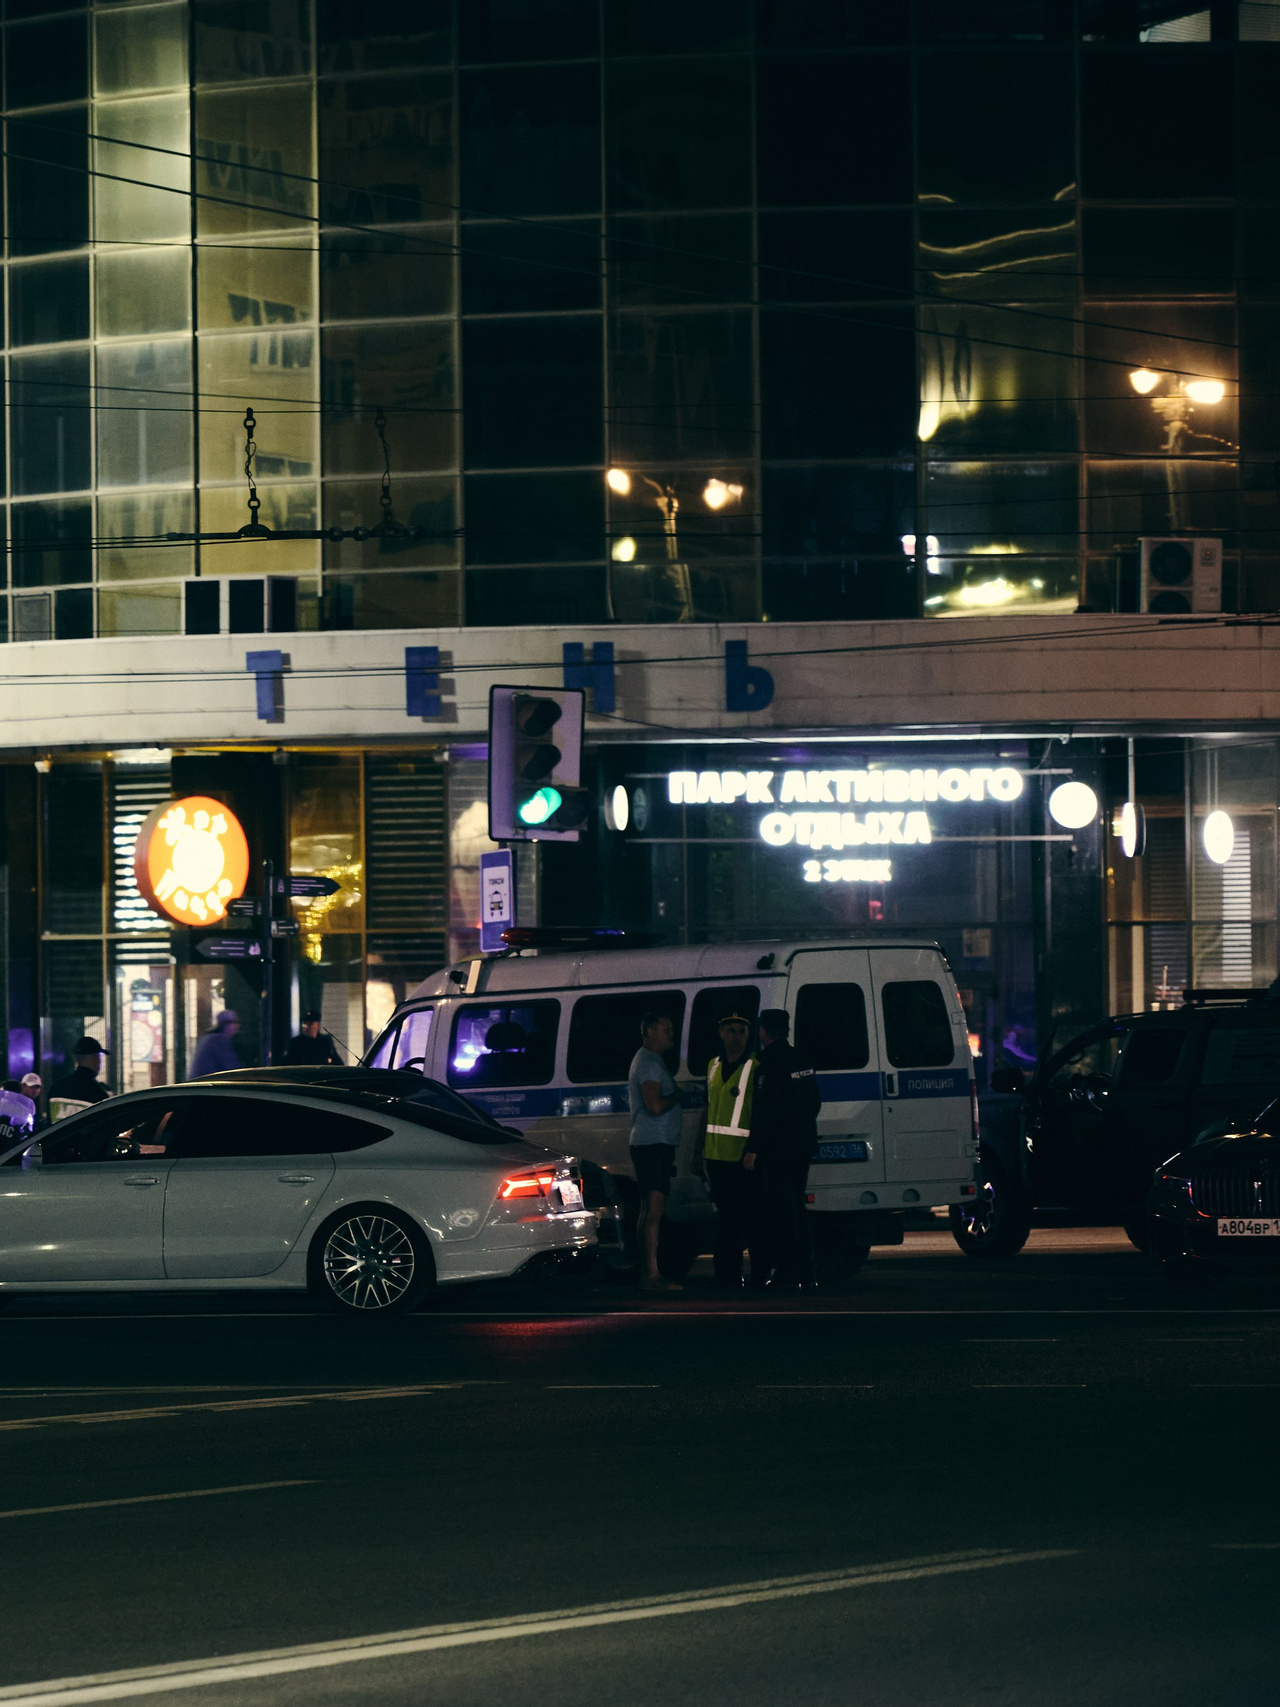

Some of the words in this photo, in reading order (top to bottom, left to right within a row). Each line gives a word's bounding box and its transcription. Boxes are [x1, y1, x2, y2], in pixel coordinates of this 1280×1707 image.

[669, 771, 775, 803] ПАРК
[780, 767, 1024, 802] АКТИВНОГО
[760, 811, 932, 850] ОТДЫХА
[908, 1078, 955, 1090] ПОЛИЦИЯ
[820, 1145, 847, 1159] 0592
